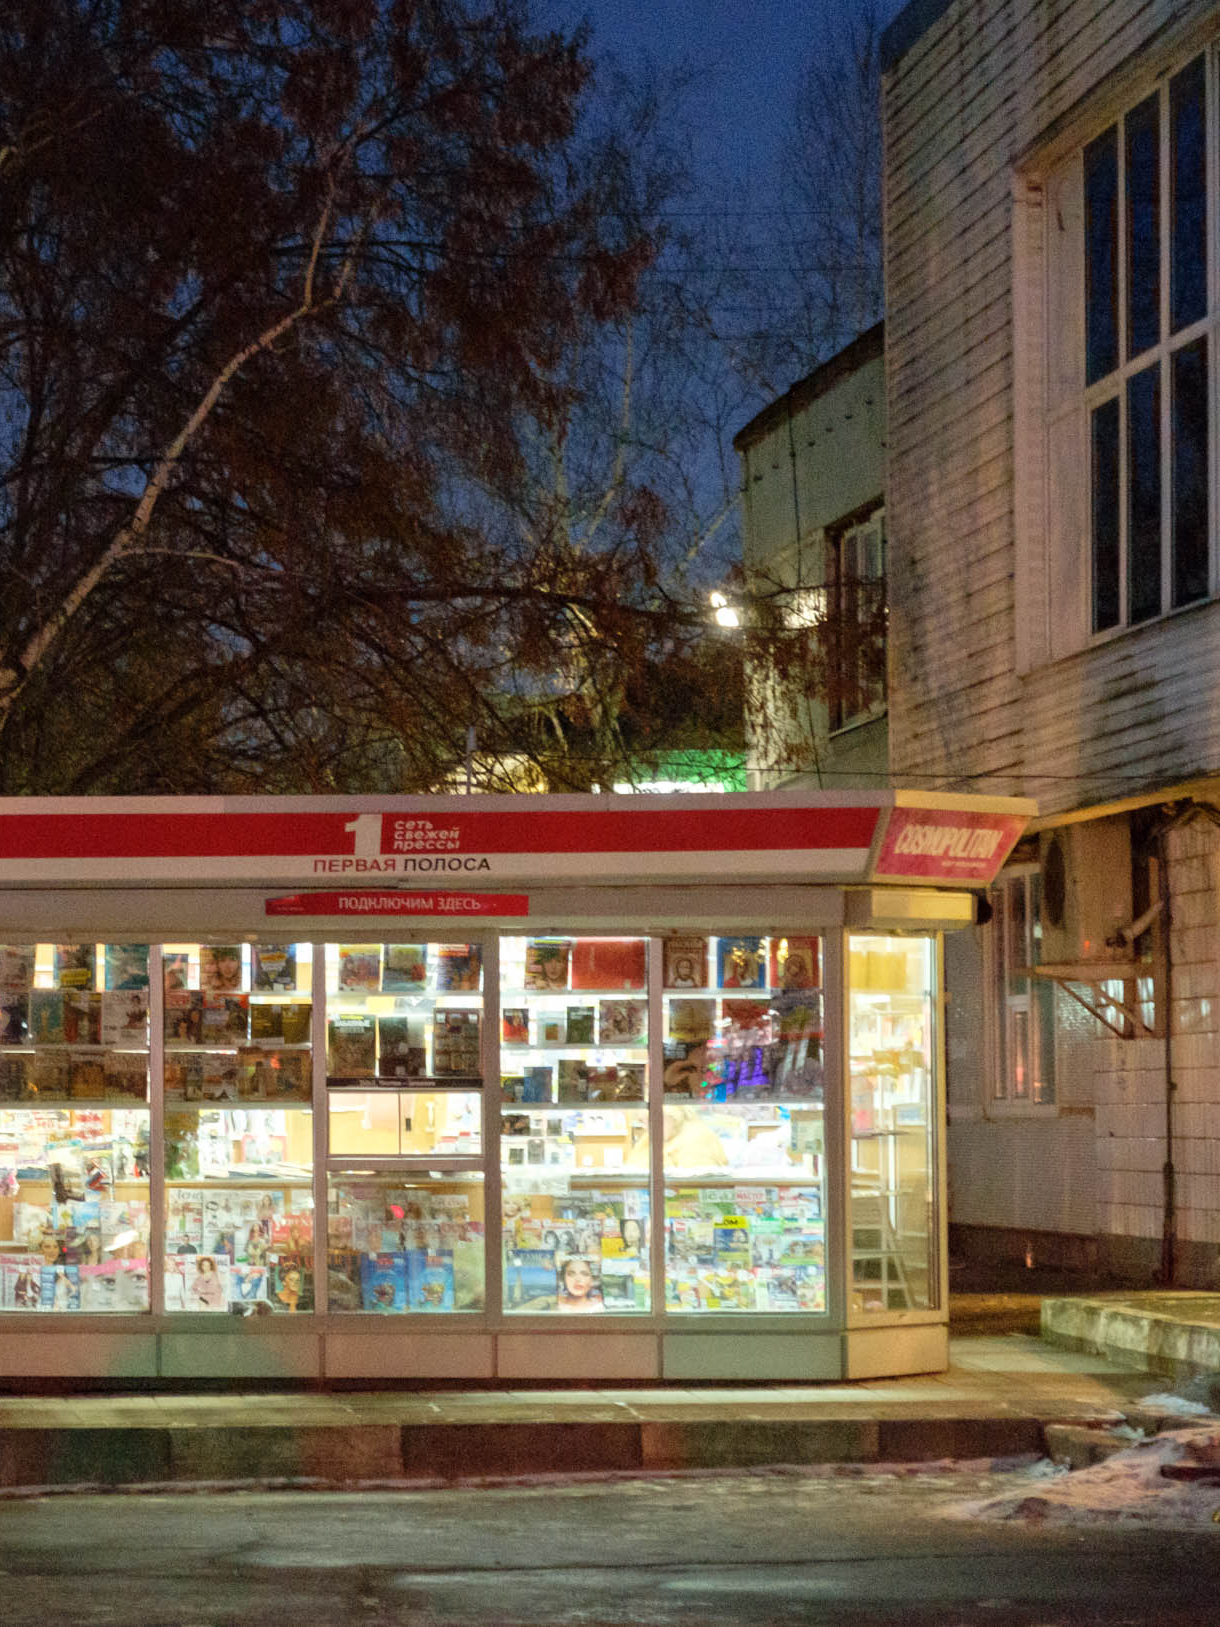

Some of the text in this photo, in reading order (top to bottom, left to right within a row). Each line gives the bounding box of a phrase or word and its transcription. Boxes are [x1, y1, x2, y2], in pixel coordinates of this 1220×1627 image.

[394, 820, 433, 830] сеть
[345, 814, 383, 854] 1
[394, 828, 461, 840] свежей
[894, 824, 1004, 859] COSMOPOLITAN
[393, 841, 460, 851] прессы
[313, 857, 491, 873] ПЕРВАЯ ПОЛОСА
[338, 896, 481, 911] ПОДКЛЮЧИМ ЗДЕСЬ
